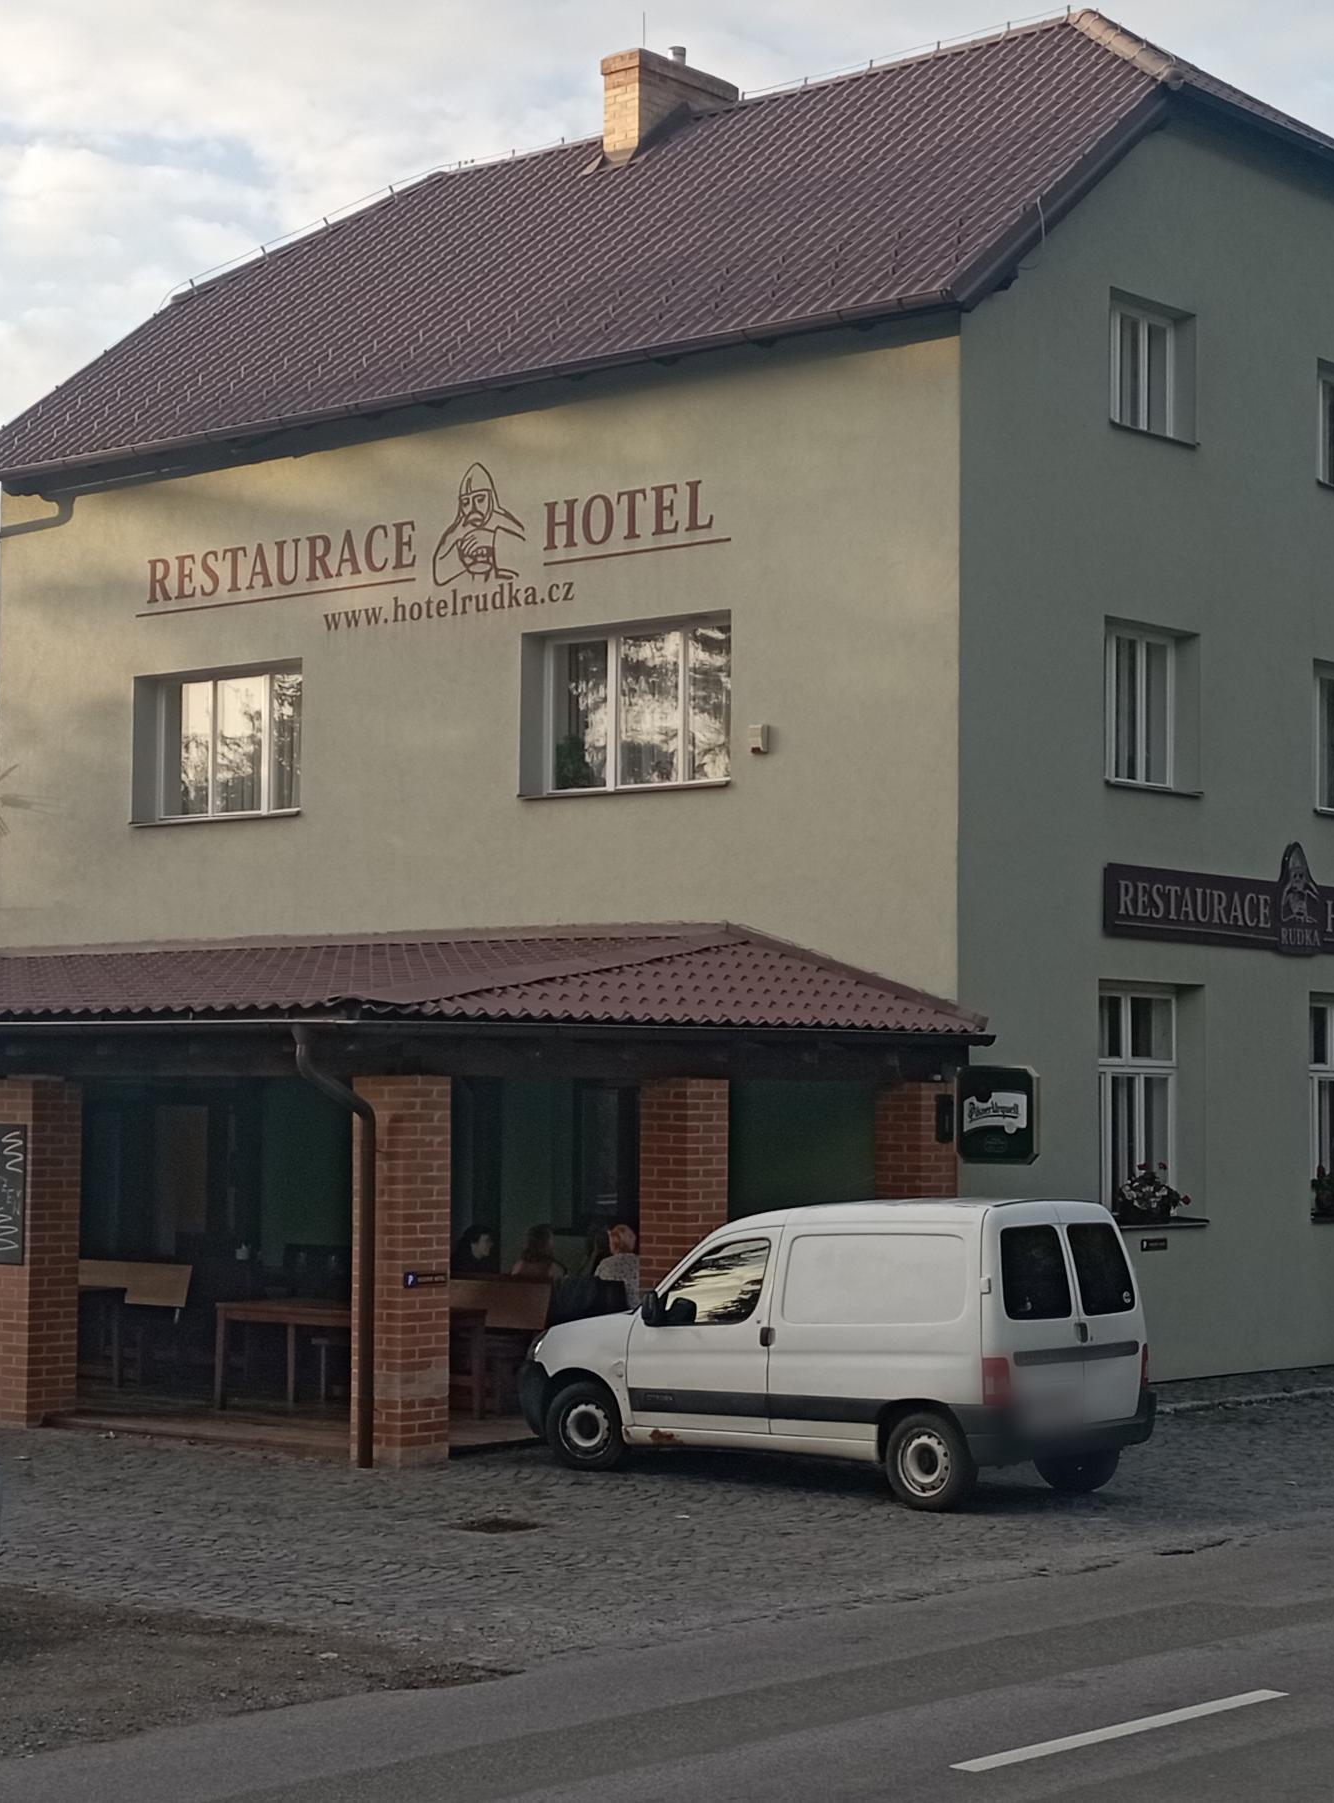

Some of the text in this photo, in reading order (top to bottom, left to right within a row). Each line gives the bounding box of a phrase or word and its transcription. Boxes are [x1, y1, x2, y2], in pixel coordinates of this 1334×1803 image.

[146, 479, 715, 605] RESTAURACE HOTEL
[322, 577, 576, 633] www.hotelrudka.cz
[1118, 879, 1271, 929] RESTAURACE
[1281, 927, 1321, 947] RUDKA
